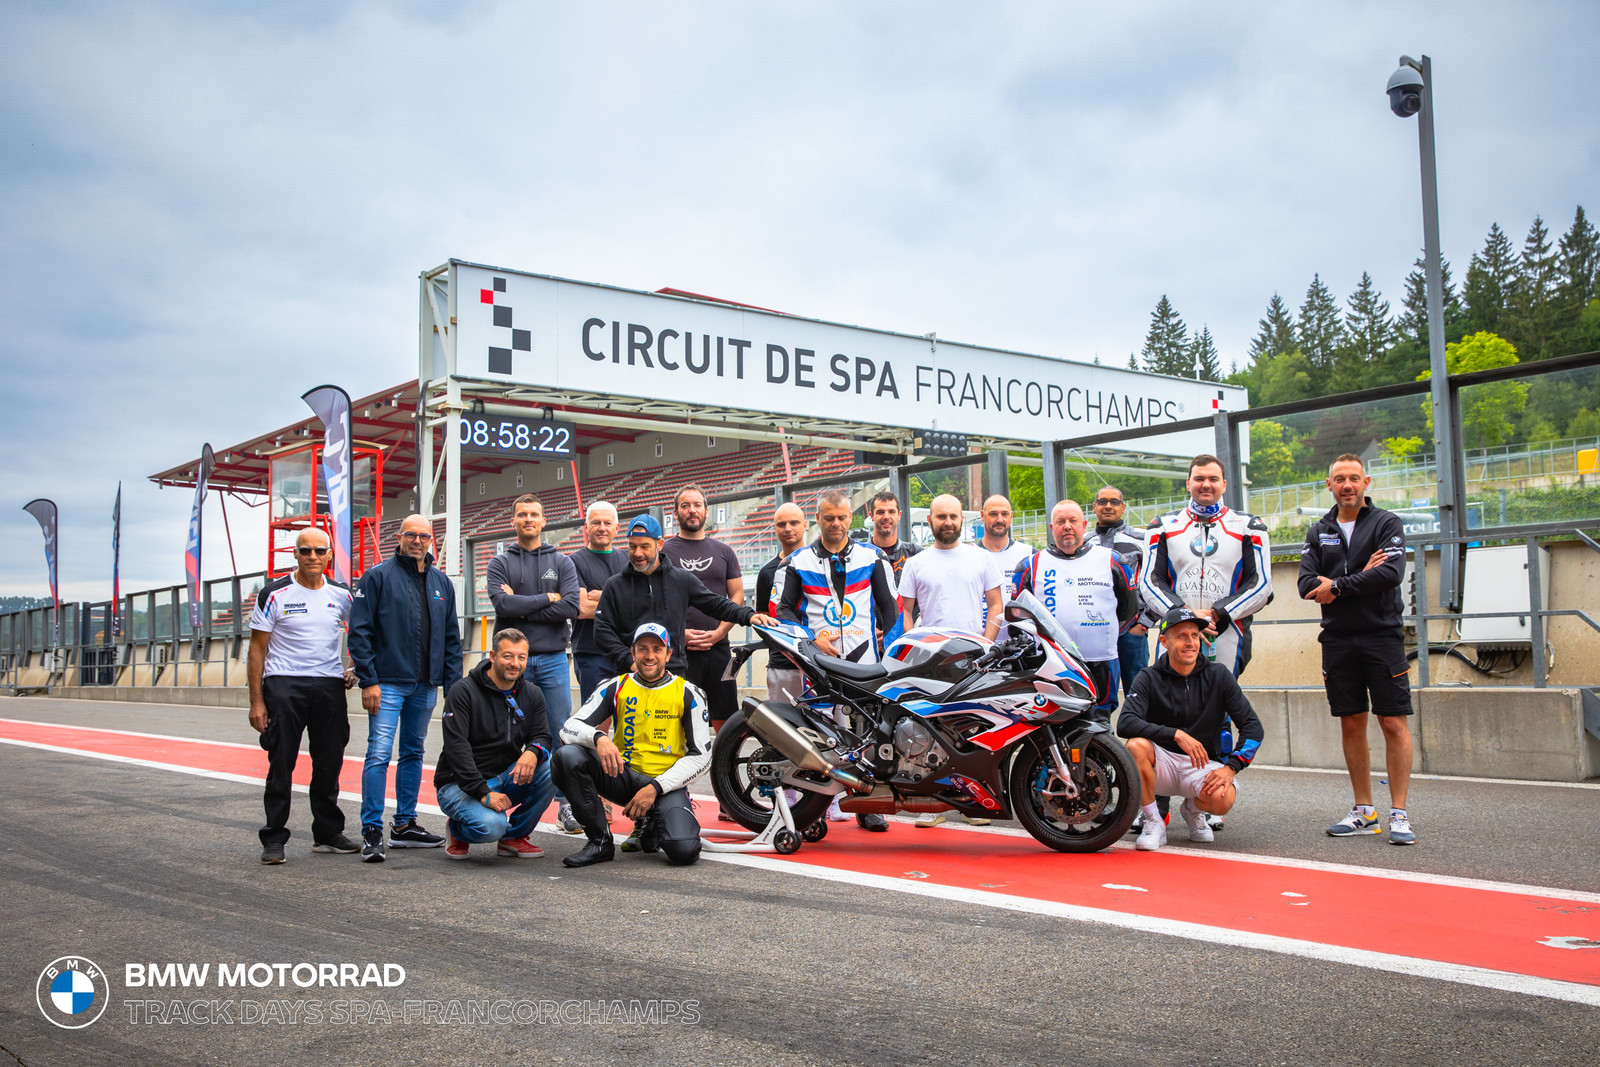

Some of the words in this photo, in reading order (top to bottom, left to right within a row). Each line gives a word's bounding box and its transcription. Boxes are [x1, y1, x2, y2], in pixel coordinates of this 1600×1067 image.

[582, 317, 751, 380] CIRCUIT
[766, 343, 816, 389] DE
[828, 353, 901, 400] SPA
[460, 418, 570, 453] 08:58:22
[666, 516, 671, 527] P
[719, 510, 724, 521] T
[1044, 569, 1056, 617] DAYS
